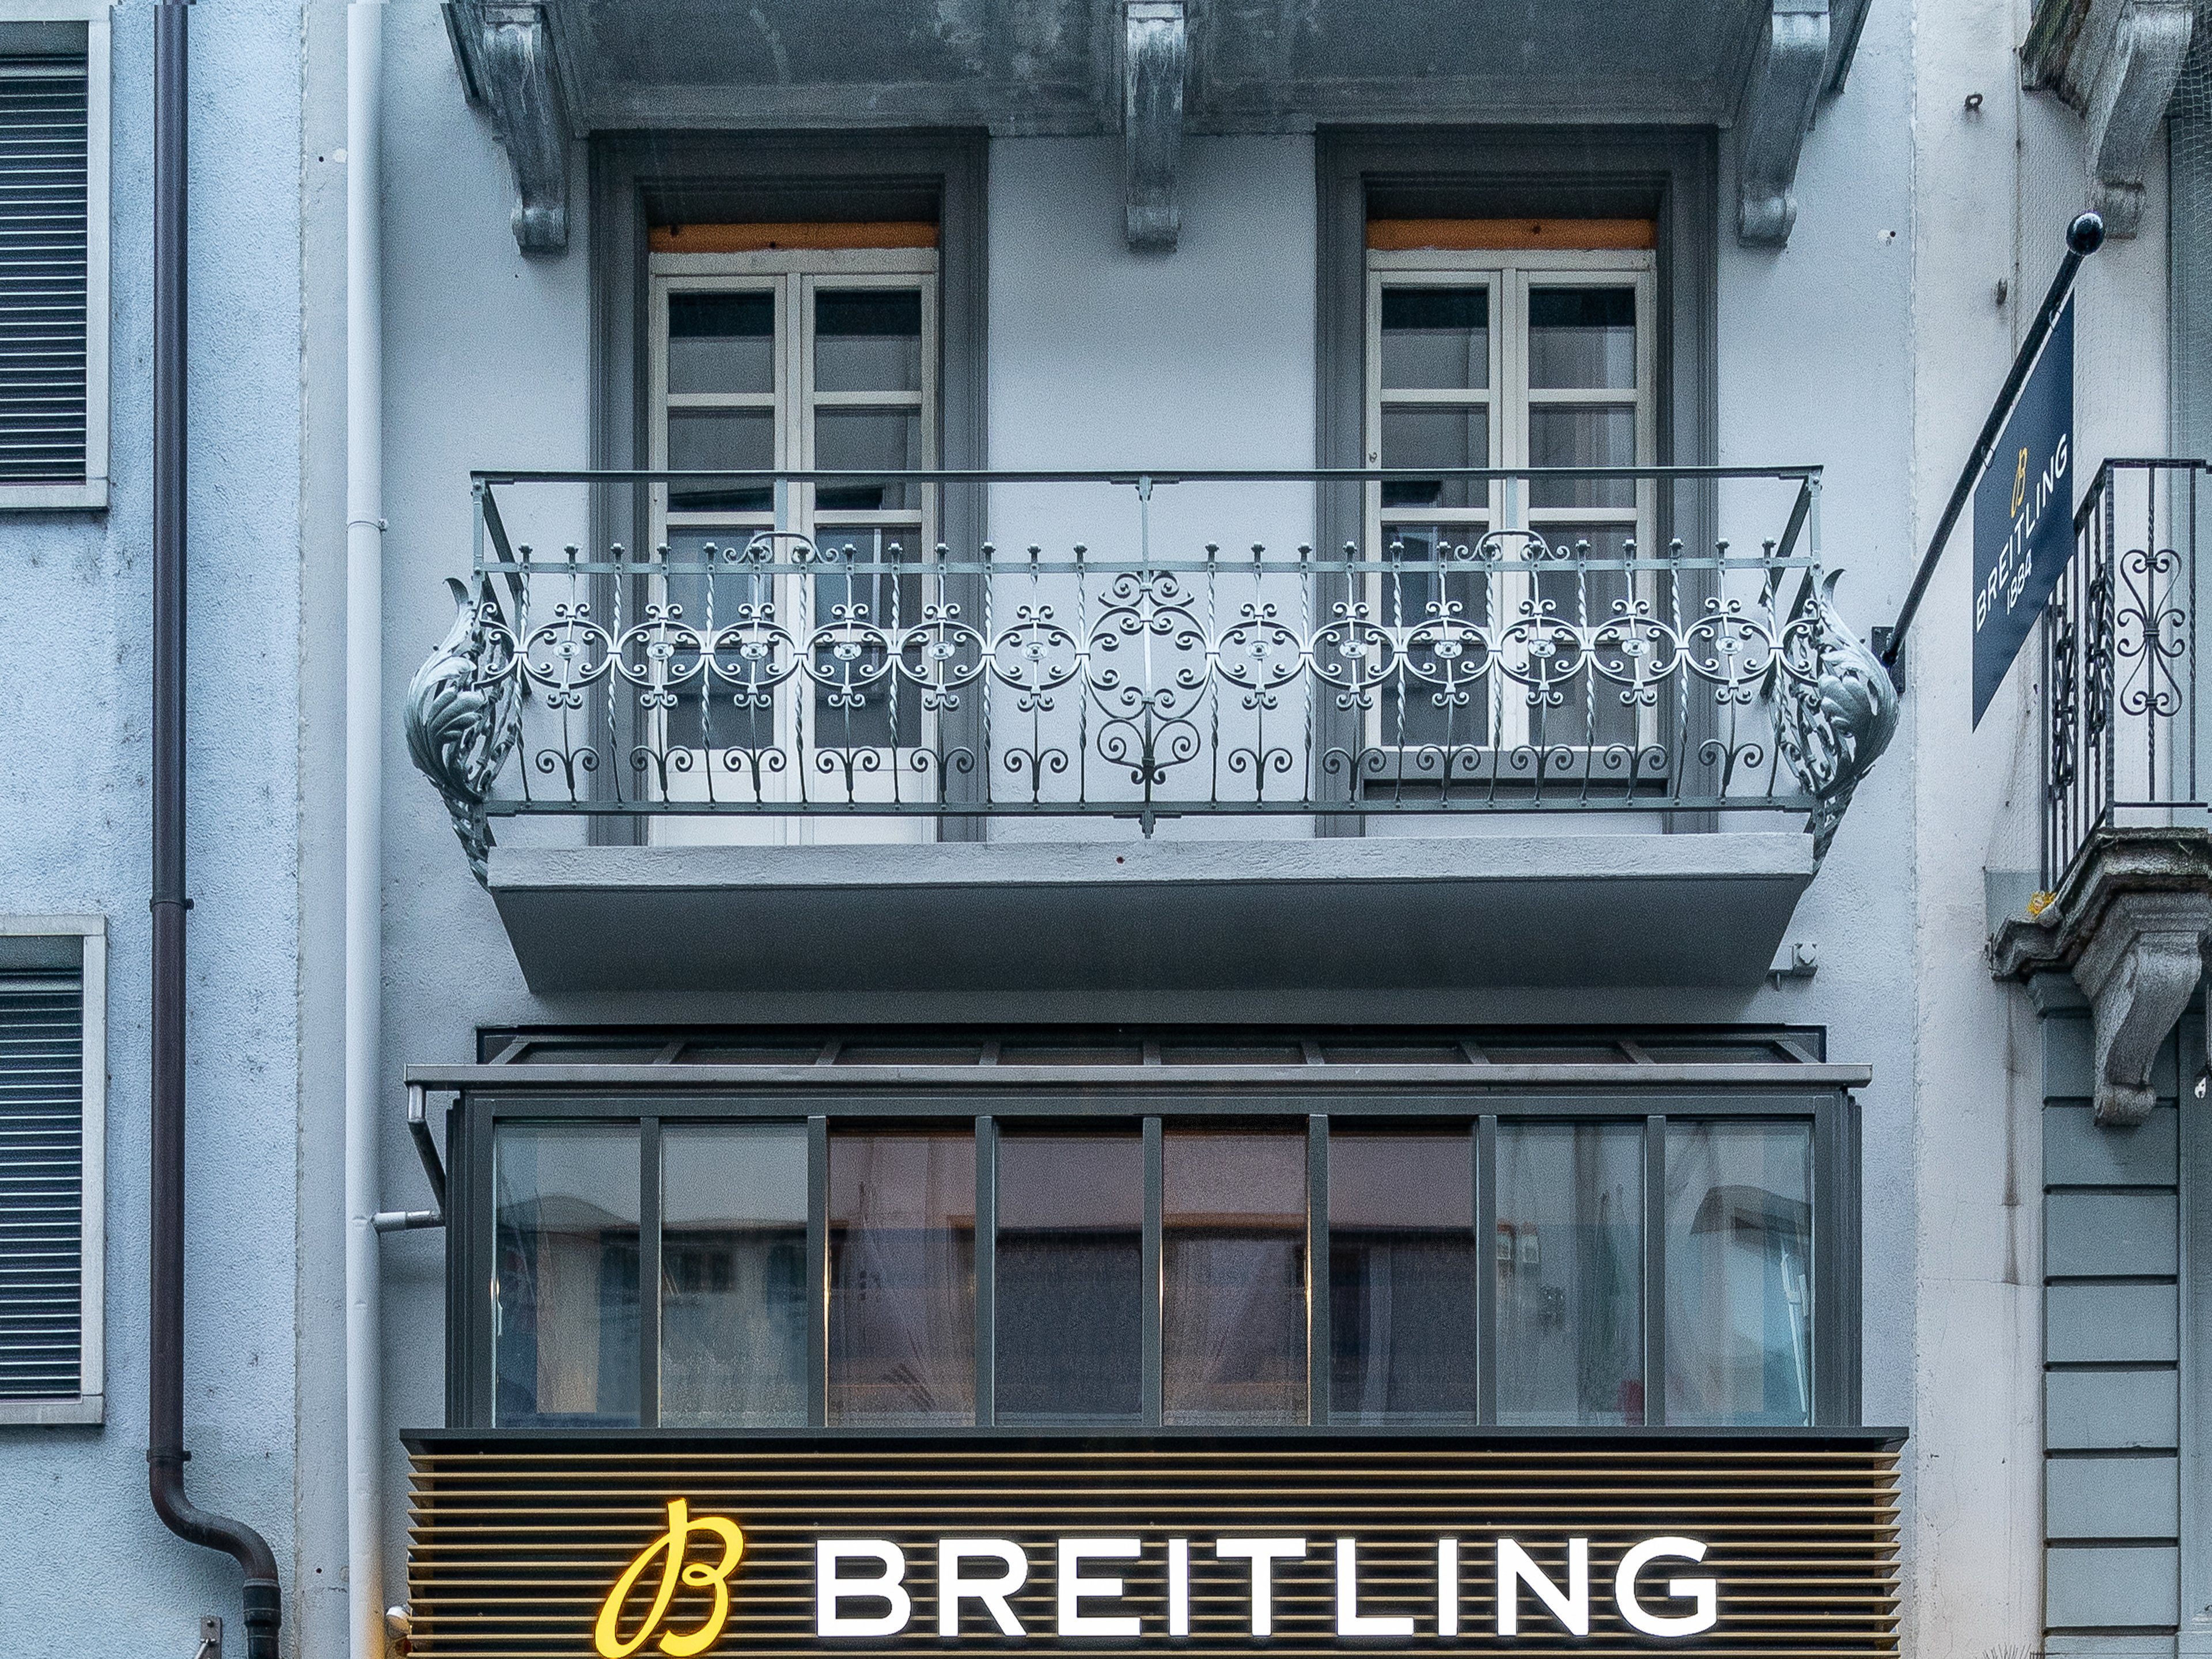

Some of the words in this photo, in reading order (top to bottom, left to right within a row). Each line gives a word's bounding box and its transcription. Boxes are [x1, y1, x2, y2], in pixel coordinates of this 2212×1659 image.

[1976, 434, 2067, 633] BREITLING
[2006, 548, 2032, 615] 1884
[816, 1536, 1717, 1637] BREITLING
